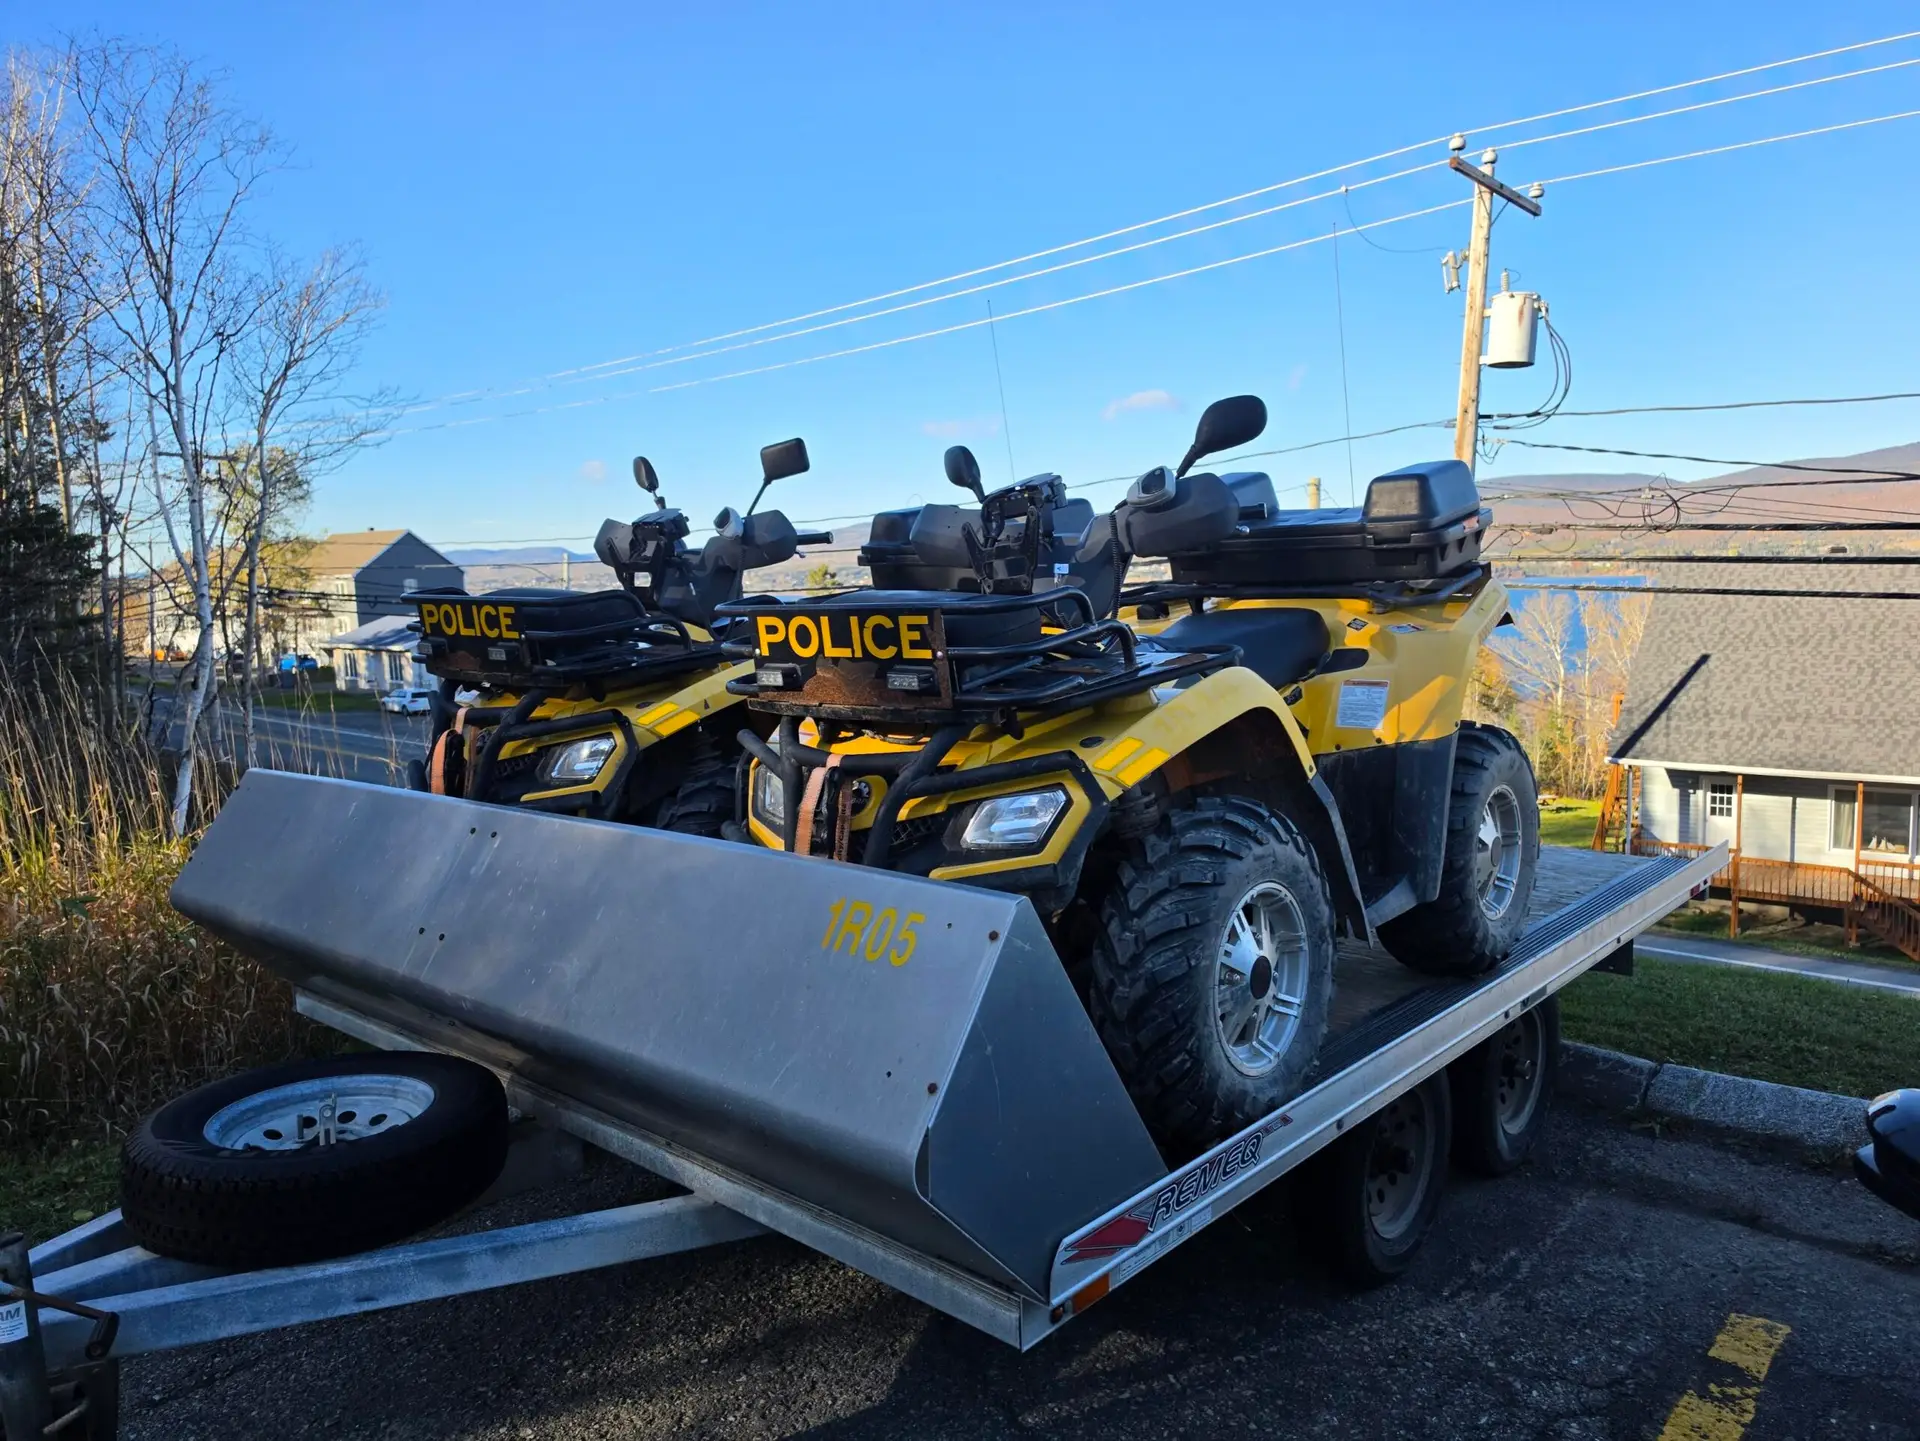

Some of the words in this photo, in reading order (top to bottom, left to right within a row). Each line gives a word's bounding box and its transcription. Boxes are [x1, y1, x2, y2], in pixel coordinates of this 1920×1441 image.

[421, 603, 520, 640] POLICE
[756, 614, 933, 660] POLICE
[821, 895, 927, 968] 1R05
[1146, 1130, 1264, 1233] REMEQ
